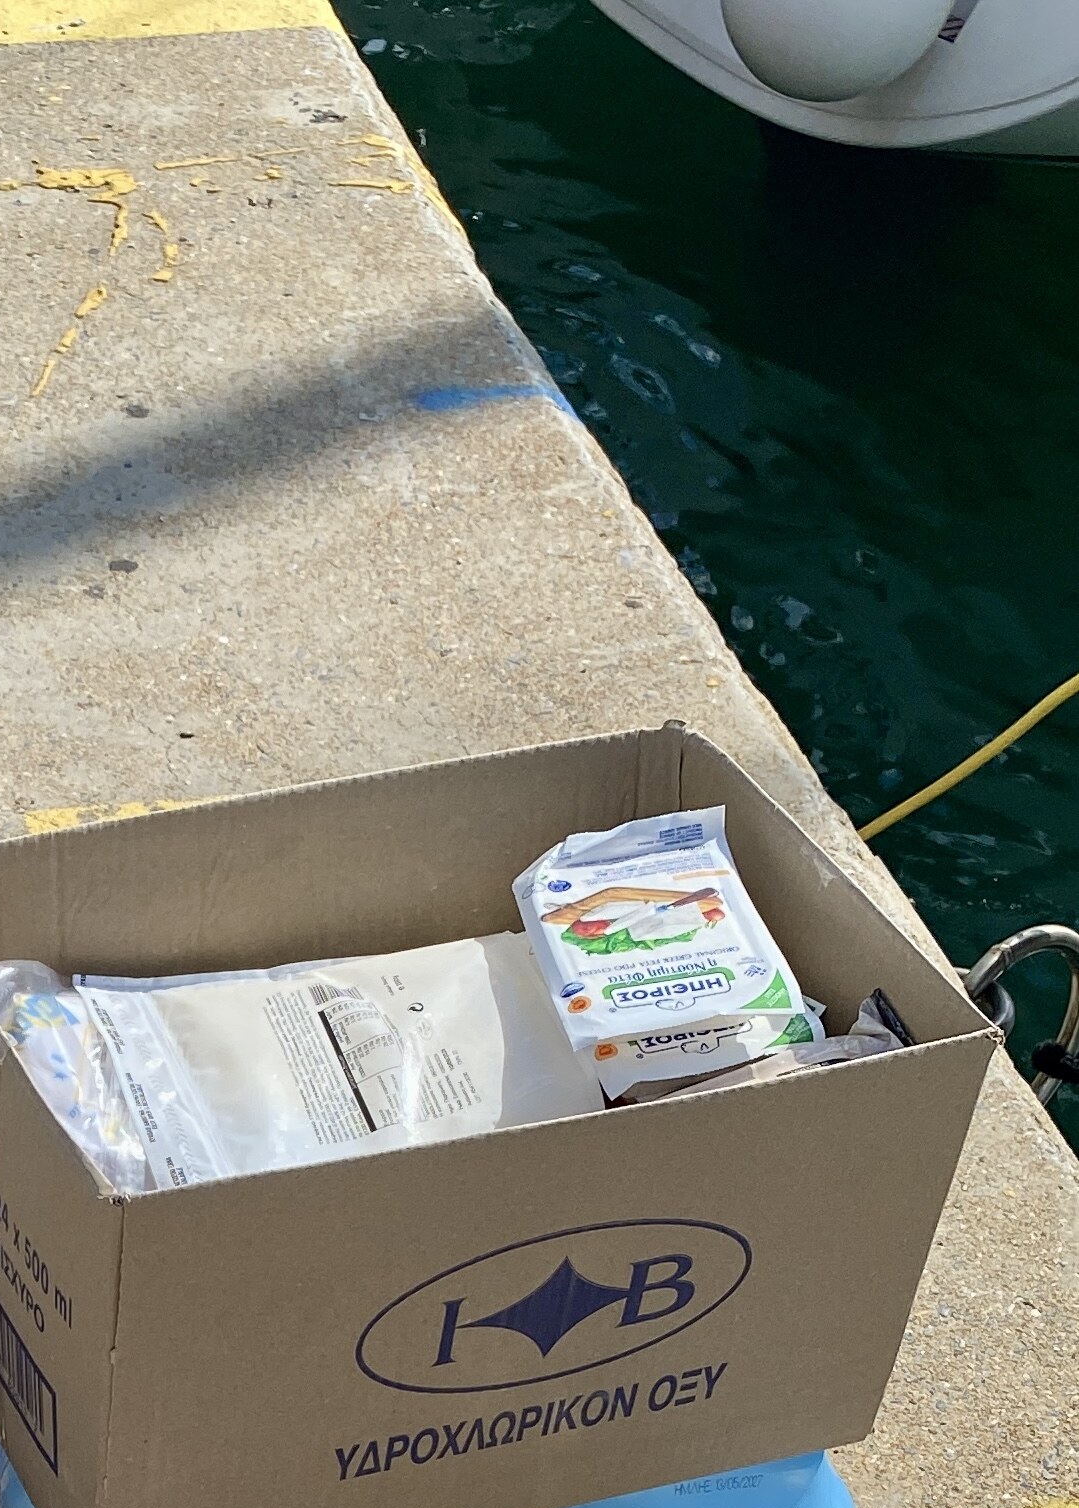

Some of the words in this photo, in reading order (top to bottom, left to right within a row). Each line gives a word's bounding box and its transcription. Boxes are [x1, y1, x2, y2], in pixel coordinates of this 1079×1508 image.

[607, 969, 645, 986] Φέτα
[23, 1235, 50, 1294] 500
[53, 1274, 73, 1329] ml
[335, 1384, 639, 1480] ΥΔΡΟΧΛΩΡΙΚΟΝ
[648, 1363, 729, 1413] ΟΞΥ
